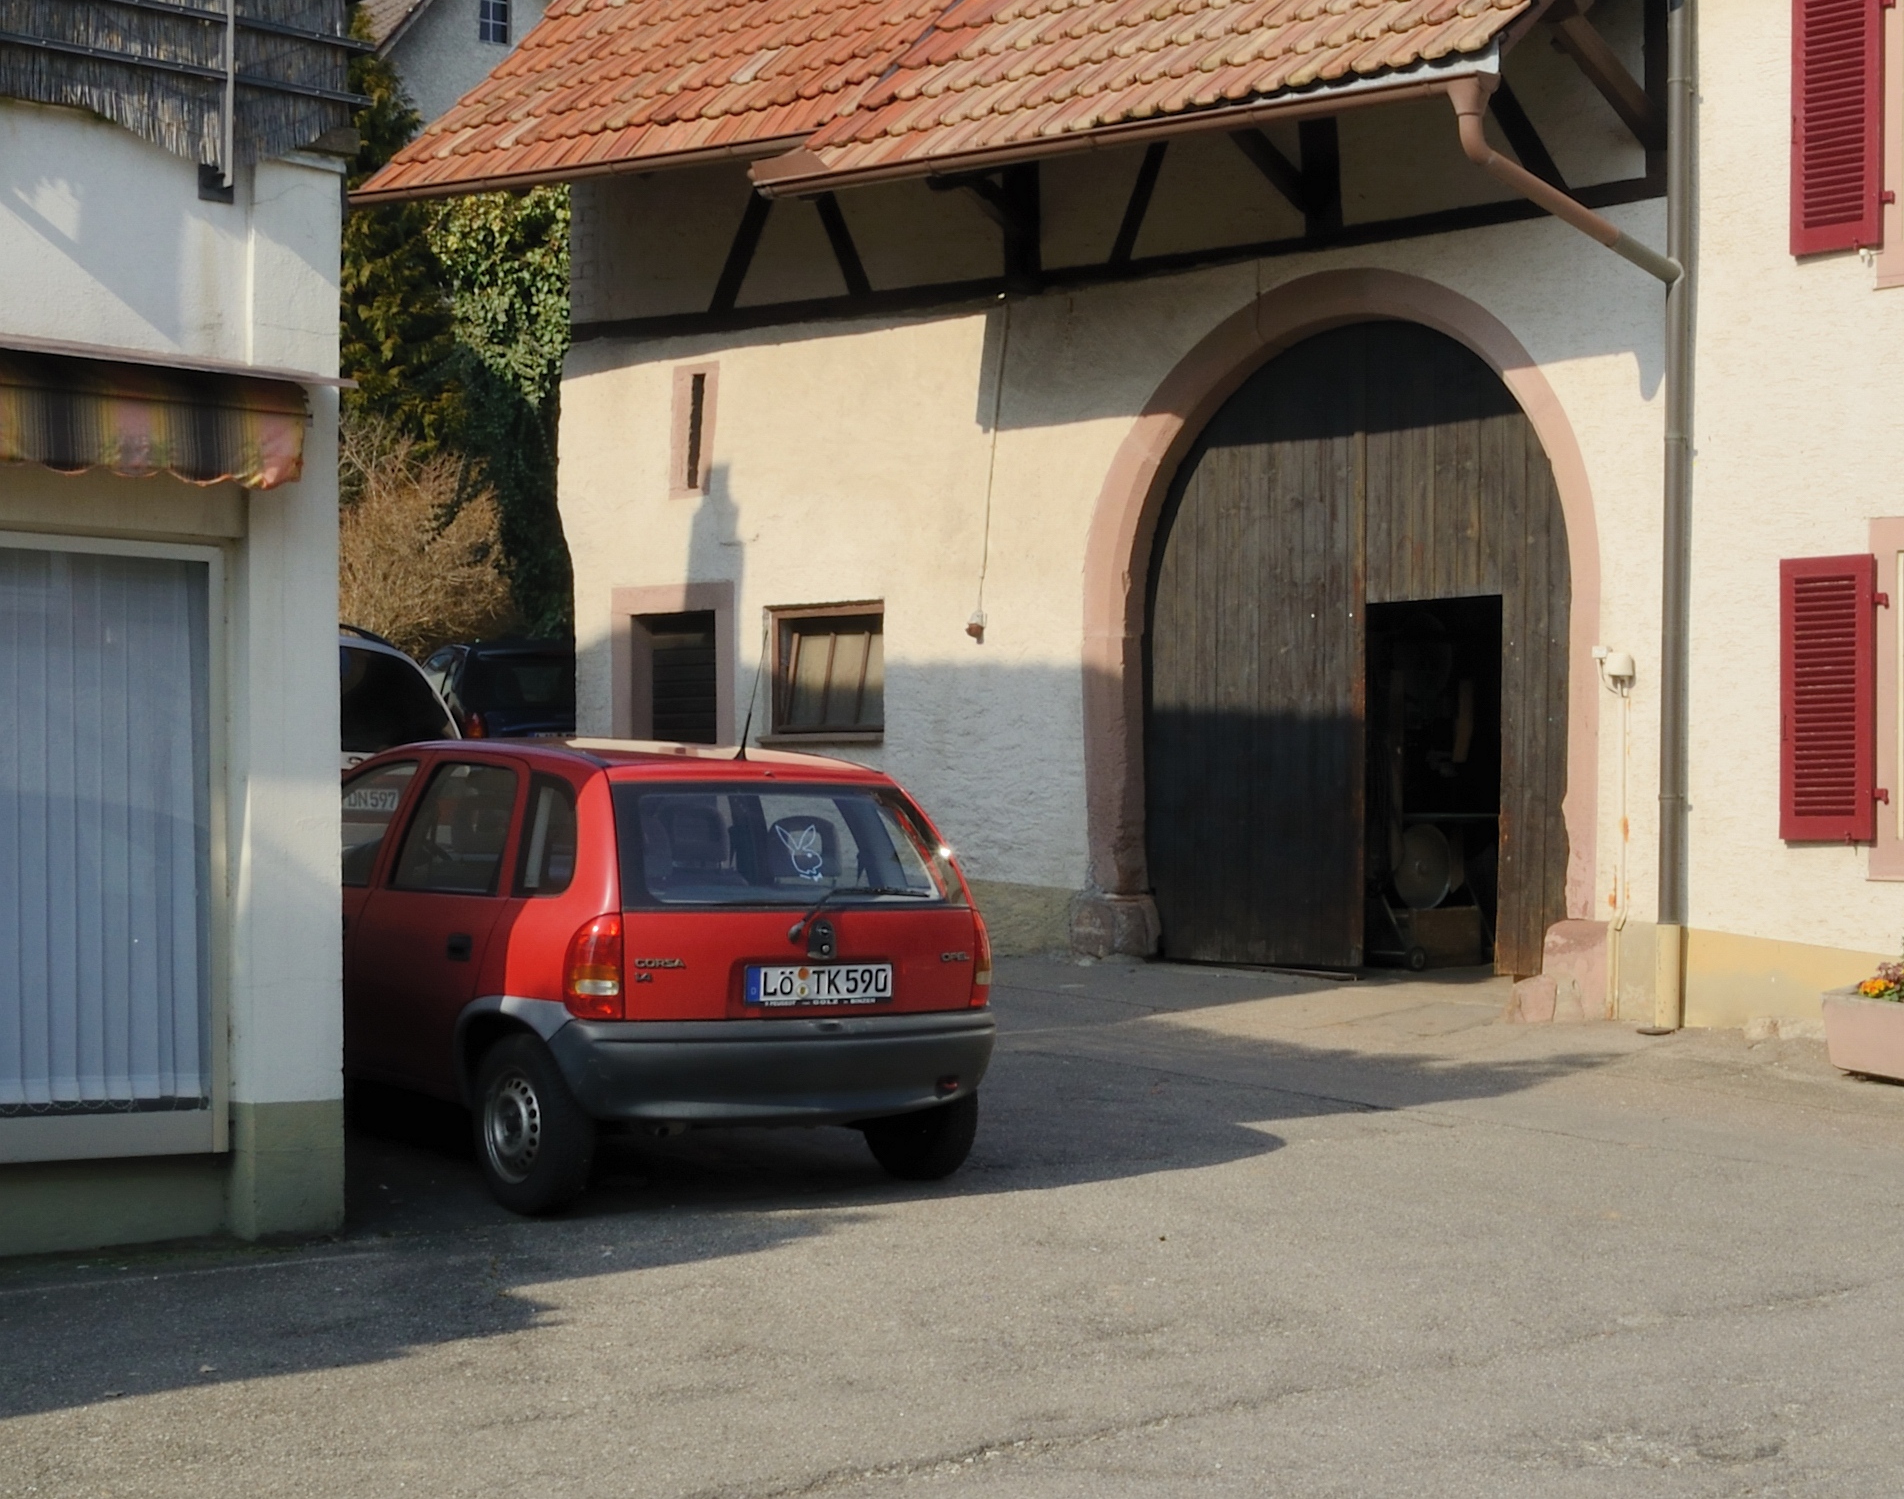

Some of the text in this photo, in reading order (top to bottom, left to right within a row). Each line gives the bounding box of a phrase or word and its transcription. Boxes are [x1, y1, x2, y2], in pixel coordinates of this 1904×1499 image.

[370, 791, 396, 809] 597
[635, 958, 685, 968] CORSA
[763, 971, 794, 996] LÖ
[846, 968, 887, 993] 590
